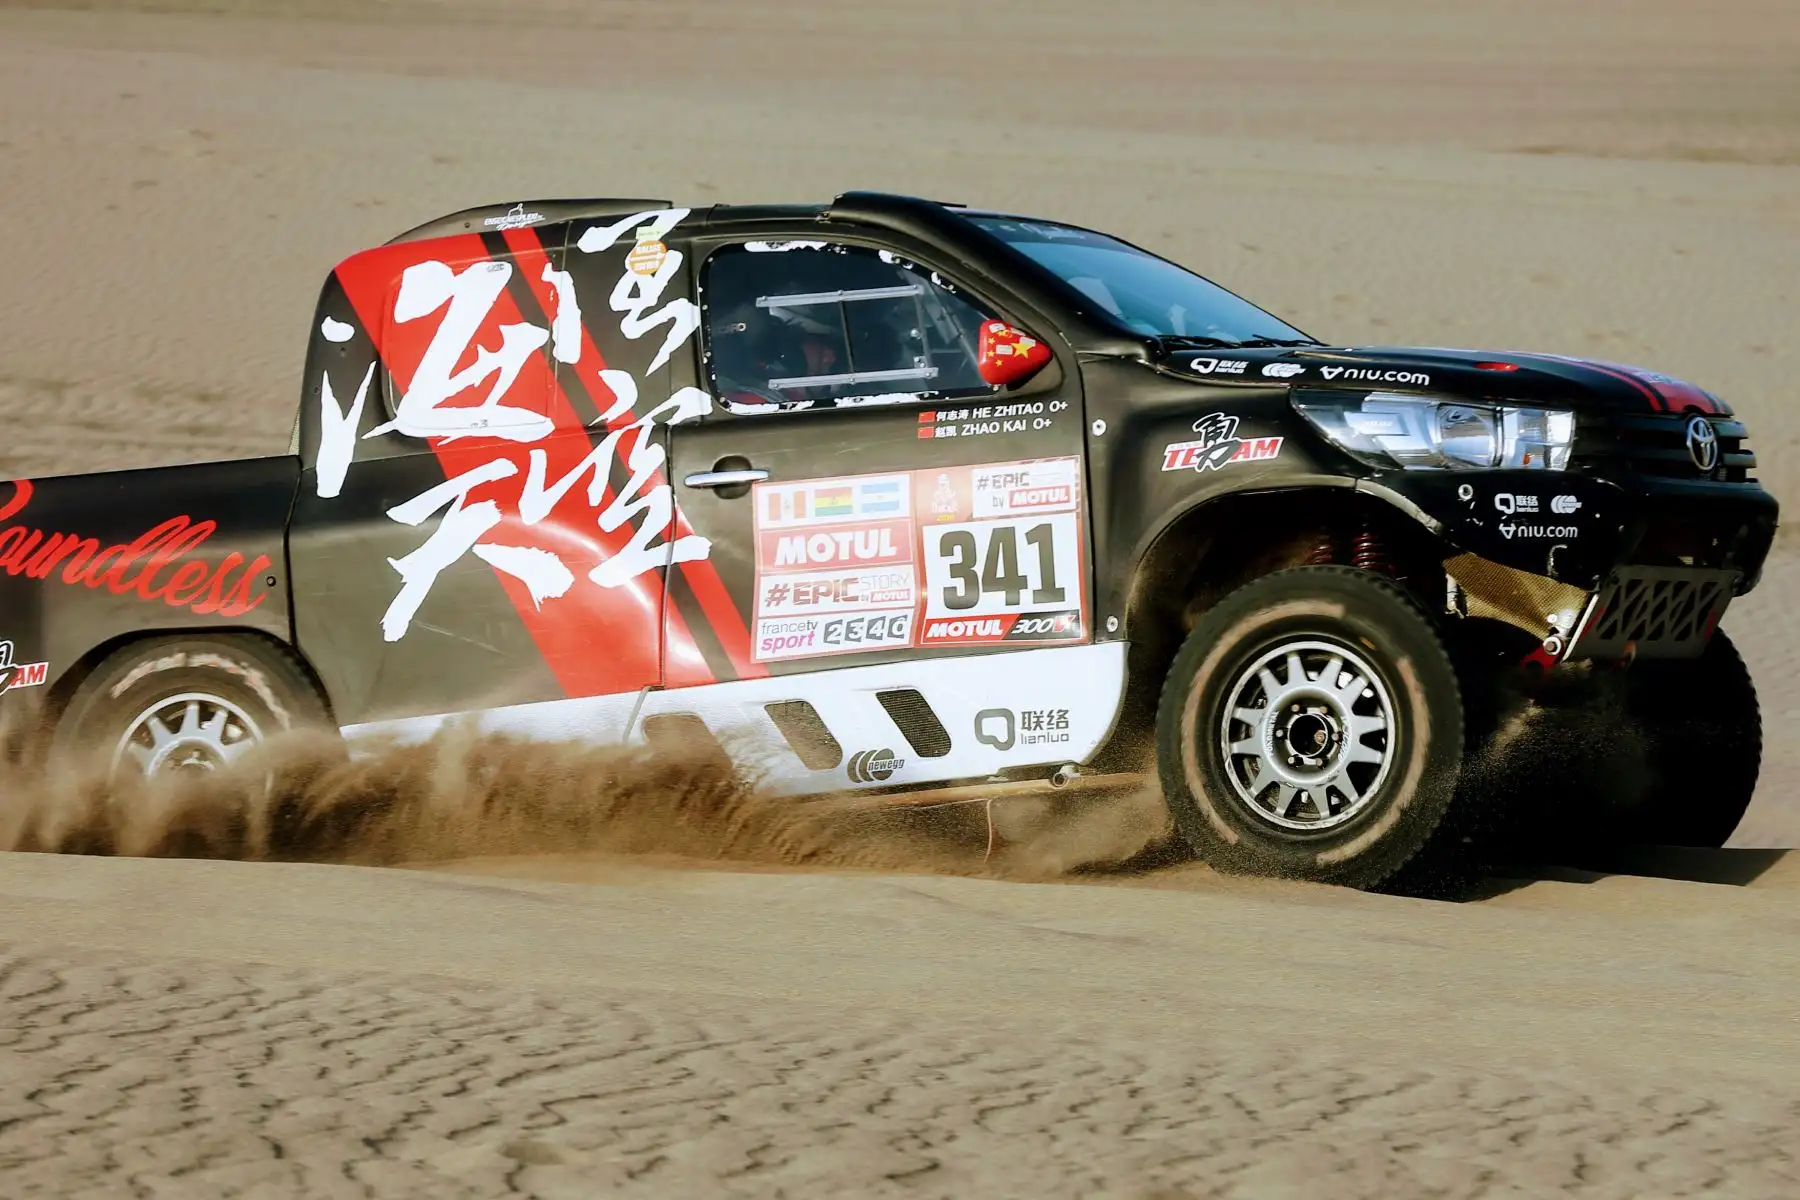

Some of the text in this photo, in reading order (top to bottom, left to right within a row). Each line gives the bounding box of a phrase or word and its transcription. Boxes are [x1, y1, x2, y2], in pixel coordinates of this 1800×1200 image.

[972, 406, 992, 419] HE
[994, 402, 1044, 417] ZHITAO
[1049, 400, 1068, 413] O+
[961, 421, 1000, 436] ZHAO
[1003, 420, 1027, 433] KAI
[1033, 417, 1052, 430] O+
[1165, 438, 1280, 468] TEAM
[977, 471, 1030, 491] #EPIC
[1012, 488, 1069, 505] MOTUL
[776, 528, 897, 566] MOTUL
[939, 522, 1066, 610] 341
[872, 590, 911, 602] MOTUL
[926, 619, 1004, 638] MOTUL
[761, 631, 816, 654] sport
[1020, 708, 1070, 731] 联络
[1020, 731, 1070, 745] lianluo
[867, 758, 905, 771] newegg
